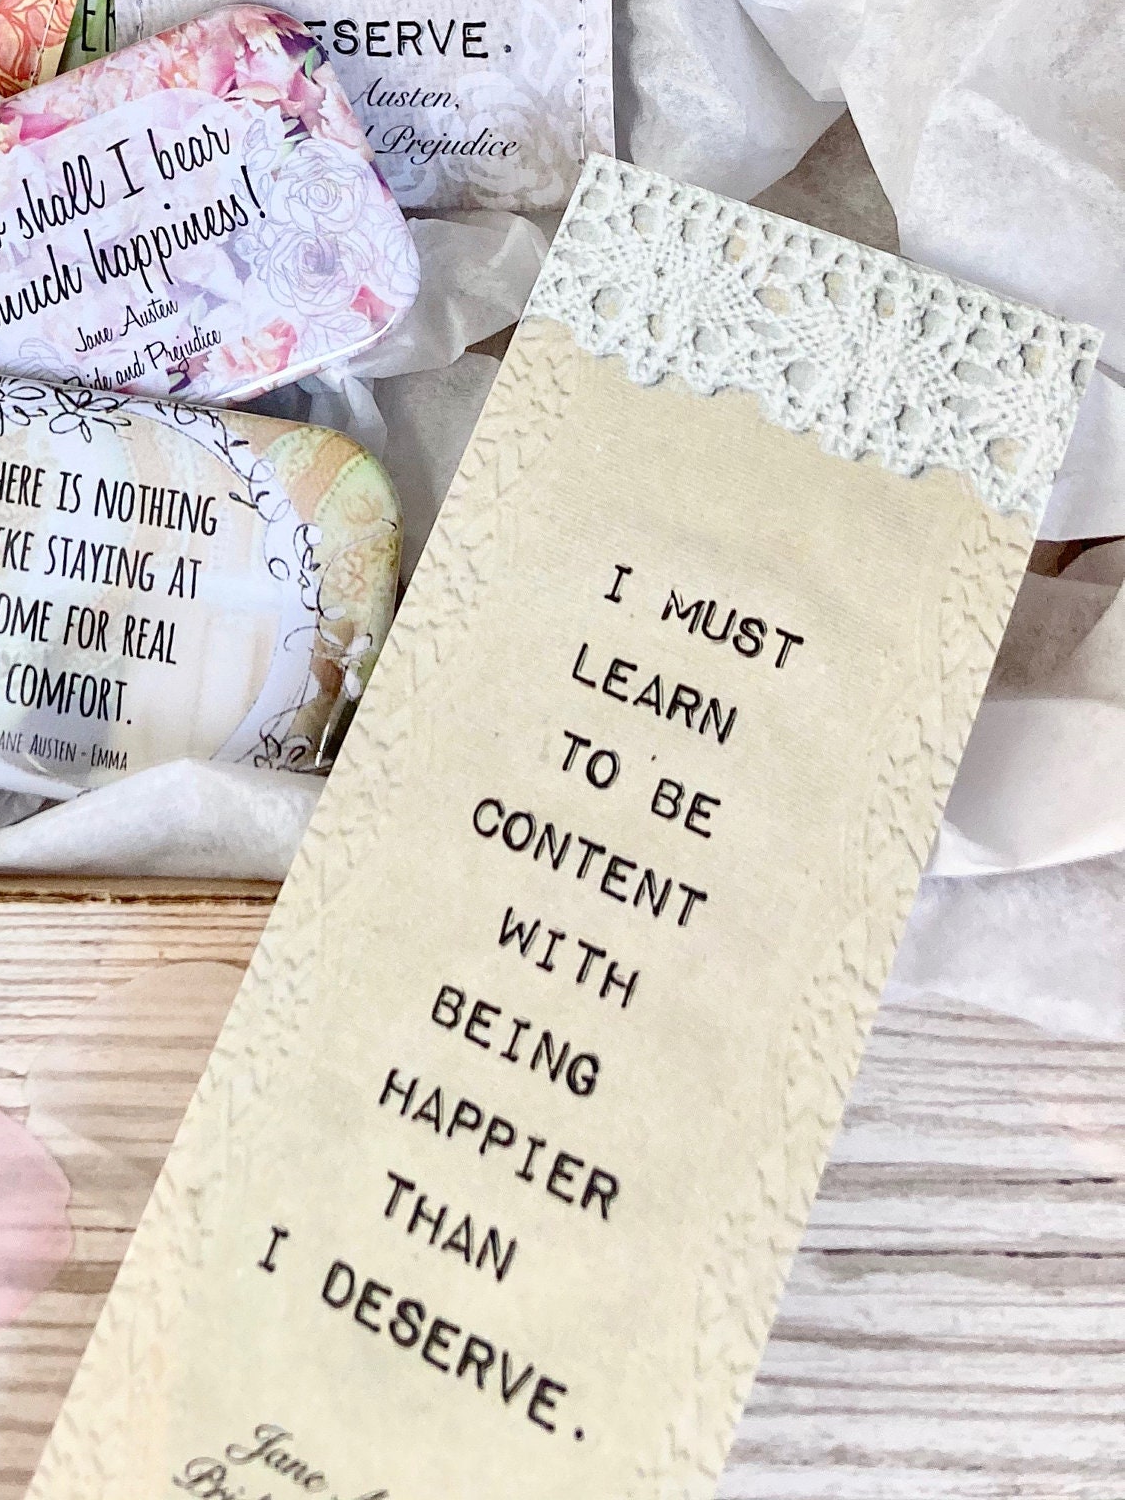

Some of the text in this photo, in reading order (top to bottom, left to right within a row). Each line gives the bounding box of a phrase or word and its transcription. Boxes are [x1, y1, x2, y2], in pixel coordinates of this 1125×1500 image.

[351, 77, 460, 111] Austen,
[16, 155, 106, 241] shall
[107, 139, 145, 199] I
[150, 120, 233, 182] bear
[375, 125, 521, 165] Prejudice
[83, 165, 268, 293] happiness!
[64, 325, 222, 390] ide and Prejudice
[75, 299, 179, 352] Jane Austen
[56, 471, 82, 511] IS
[94, 477, 217, 536] NOTHING
[44, 535, 156, 593] STAYING
[168, 557, 202, 600] AT
[603, 564, 806, 670] I MUST
[63, 605, 109, 654] FOR
[123, 615, 177, 665] REAL
[5, 662, 133, 726] COMFORT.
[570, 644, 739, 744] LEARN
[561, 731, 723, 841] TO BE
[472, 797, 709, 928] CONTENT
[497, 906, 641, 1008] WITH
[431, 986, 603, 1097] BEING
[378, 1069, 623, 1220] HAPPIER
[383, 1172, 520, 1281] THAN
[258, 1227, 589, 1442] I DESERVE.
[226, 1424, 328, 1492] Jane
